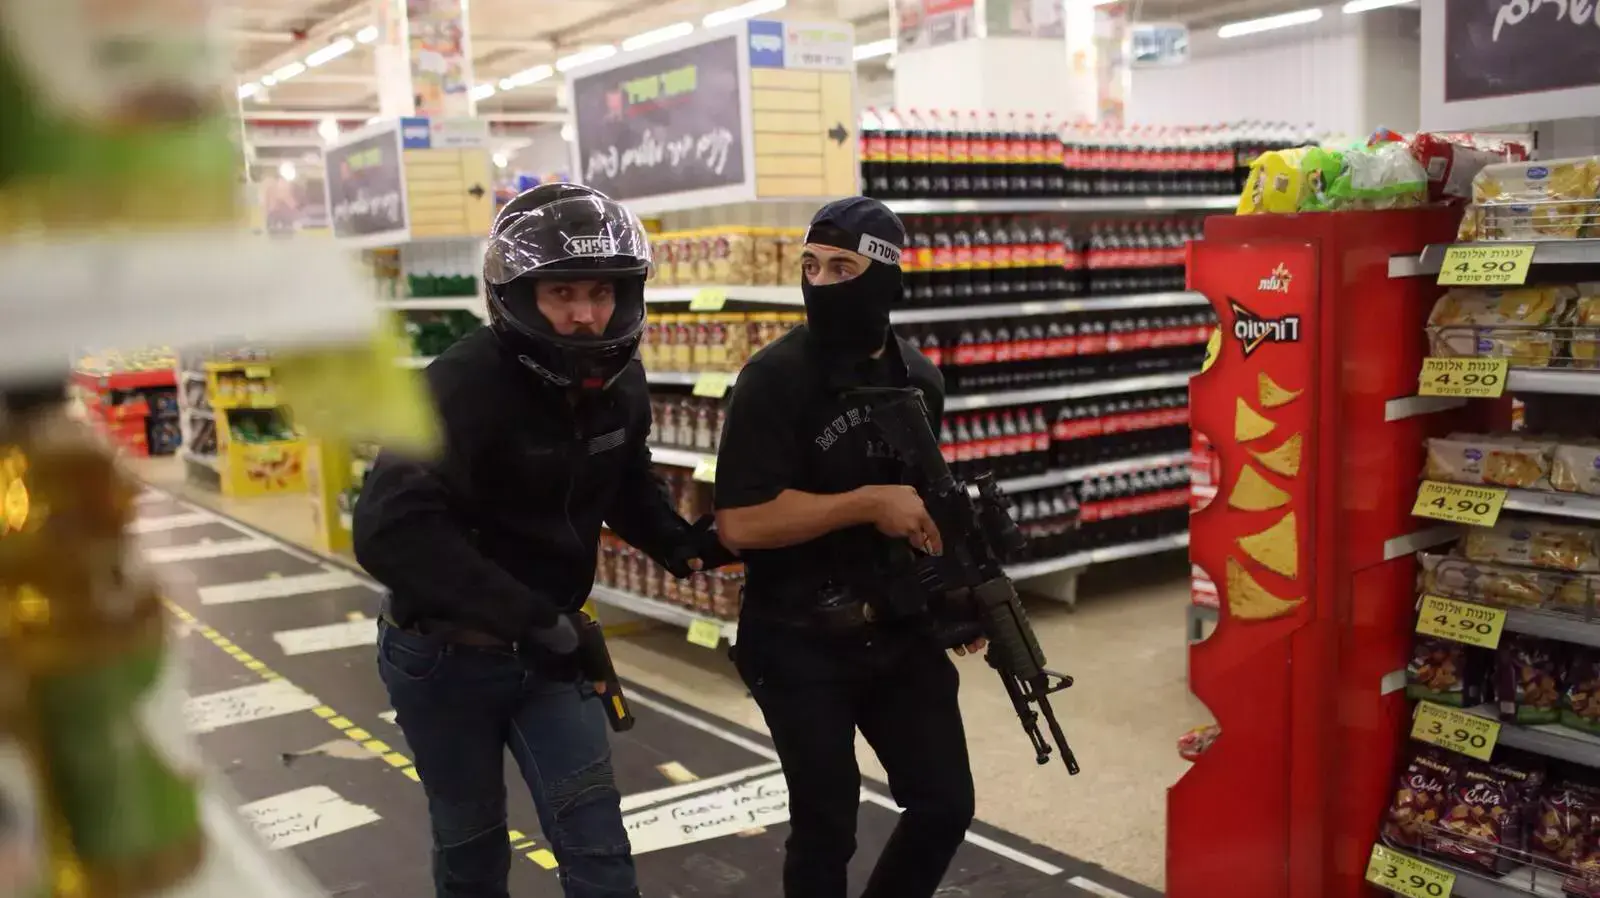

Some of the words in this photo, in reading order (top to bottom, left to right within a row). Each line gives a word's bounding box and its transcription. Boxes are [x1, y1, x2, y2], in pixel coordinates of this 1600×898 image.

[571, 239, 618, 255] SHOE
[1454, 261, 1516, 273] 4.90
[1235, 317, 1299, 341] דוריטוס
[1434, 373, 1498, 386] 4.90
[1431, 497, 1490, 515] 4.90
[1433, 615, 1491, 634] 4.90
[1428, 721, 1486, 748] 3.90
[1383, 864, 1443, 897] 3.90
